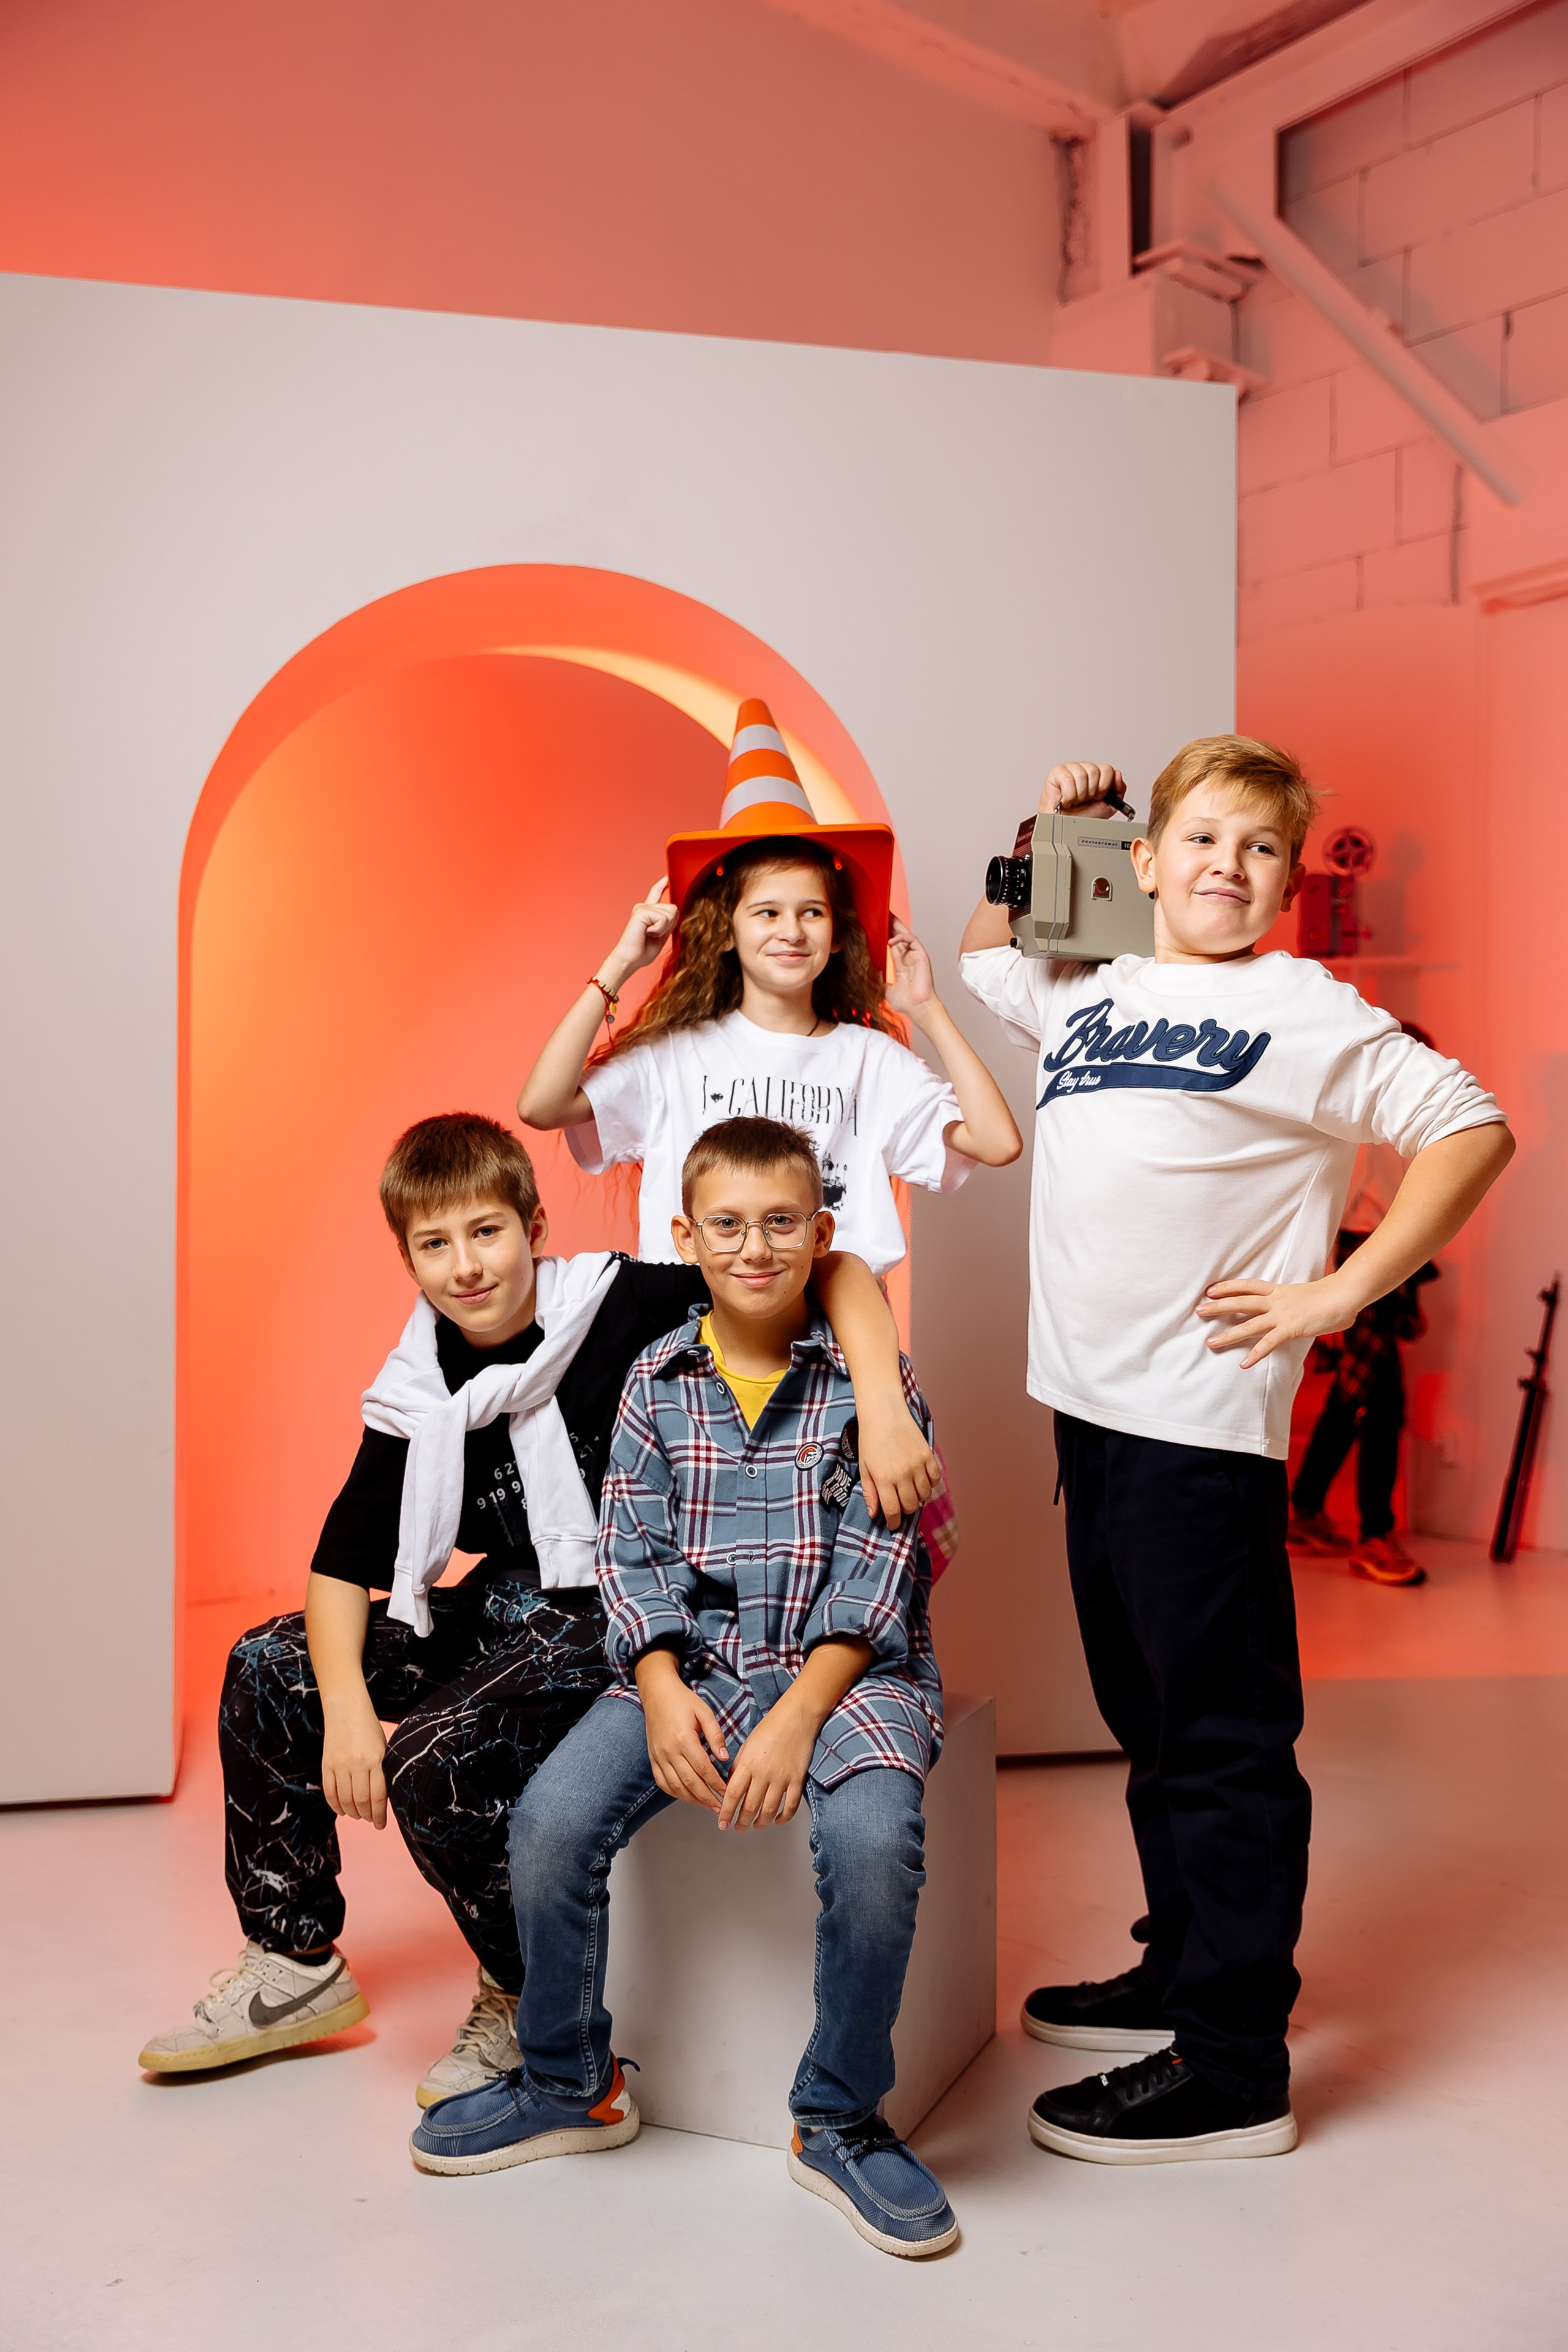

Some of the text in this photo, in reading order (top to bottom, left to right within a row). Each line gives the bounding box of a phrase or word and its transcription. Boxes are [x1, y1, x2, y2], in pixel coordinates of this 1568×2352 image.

[1044, 998, 1271, 1072] Bravery
[1056, 1070, 1101, 1093] Stay true
[825, 1476, 850, 1507] A GOOD
[833, 1463, 852, 1493] HAVE
[477, 1480, 521, 1510] 9 19 9
